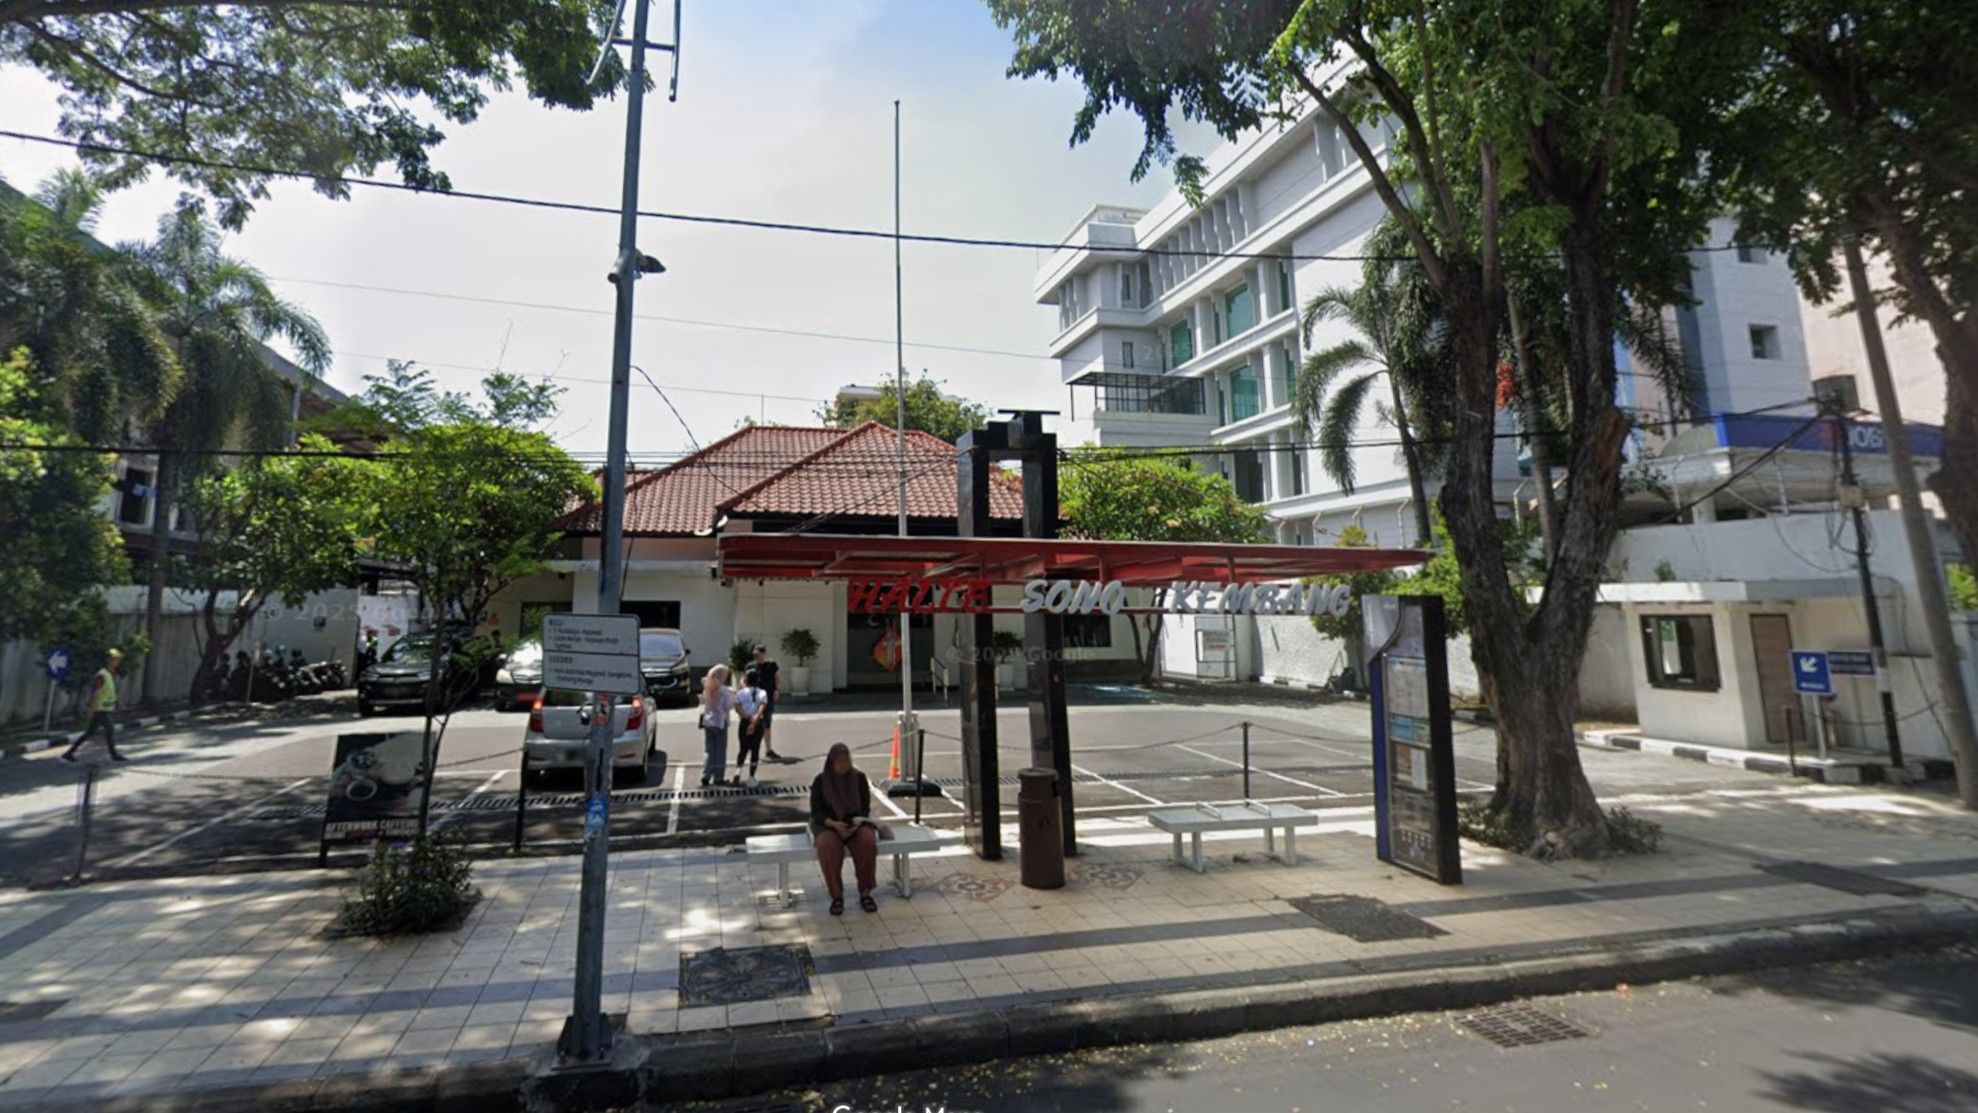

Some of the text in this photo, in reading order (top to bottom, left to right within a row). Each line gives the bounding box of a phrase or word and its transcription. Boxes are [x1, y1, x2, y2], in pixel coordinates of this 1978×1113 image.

[848, 577, 1352, 617] HALTE SONO KEMBANG
